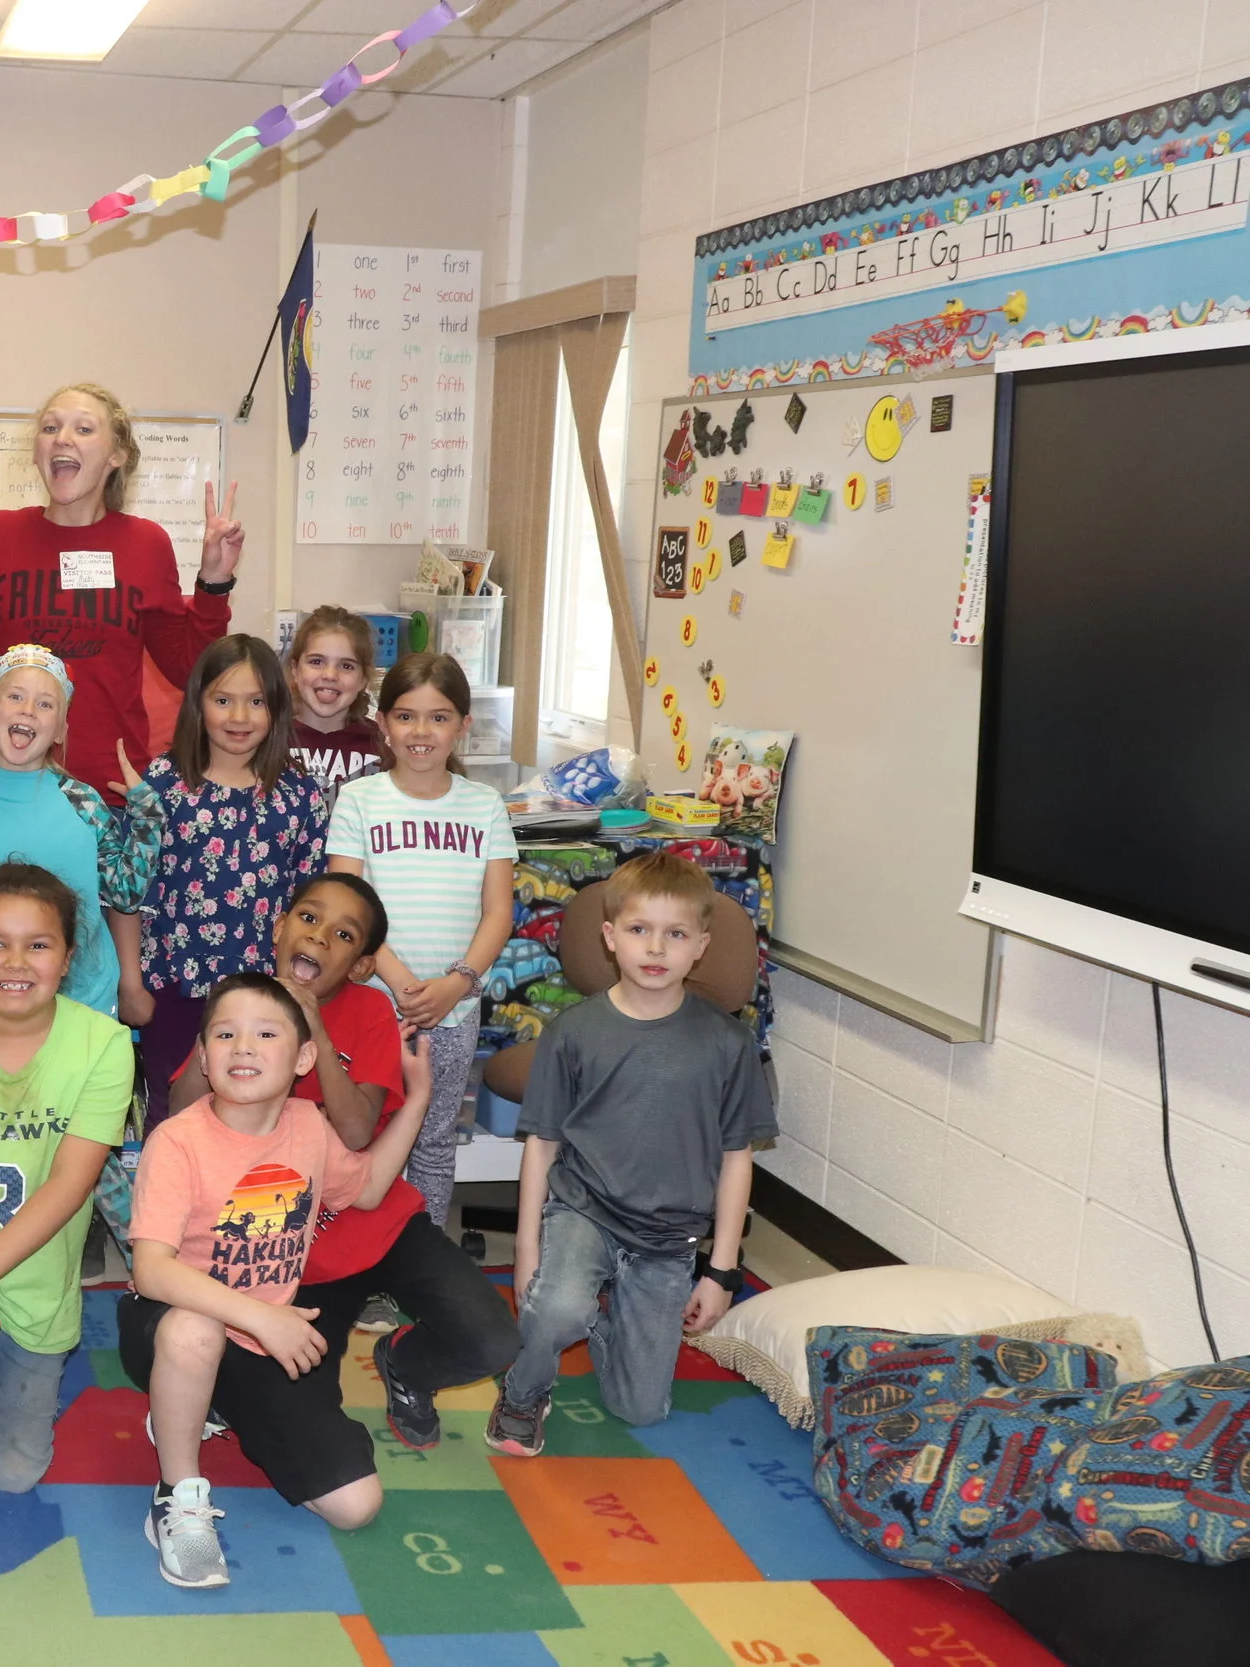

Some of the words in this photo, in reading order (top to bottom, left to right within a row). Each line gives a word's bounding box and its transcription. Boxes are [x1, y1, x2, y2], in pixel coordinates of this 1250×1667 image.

[707, 287, 730, 316] Aa
[744, 277, 763, 308] Bb
[777, 269, 800, 301] Cc
[813, 261, 837, 295] Dd
[855, 250, 876, 286] Ee
[897, 236, 919, 276] Ff
[929, 230, 960, 280] Gg
[982, 218, 1013, 257] Hh
[1041, 204, 1054, 245] Ii
[1083, 191, 1112, 252] Jj
[1140, 175, 1178, 224] Kk
[1207, 158, 1242, 209] Ll
[354, 255, 378, 270] one
[442, 254, 471, 274] first
[315, 281, 323, 298] 2
[354, 285, 375, 300] two
[402, 284, 421, 302] 2nd
[437, 288, 473, 303] second
[315, 310, 322, 328] 3
[347, 313, 380, 330] three
[402, 313, 419, 331] 3rd
[439, 315, 468, 333] third
[310, 372, 320, 390] 5
[350, 373, 372, 391] five
[436, 374, 465, 392] fifth
[309, 401, 318, 419] 6
[352, 403, 370, 418] six
[435, 404, 466, 422] sixth
[139, 434, 164, 442] Coding
[166, 435, 189, 443] Words
[309, 432, 318, 448] 7
[343, 437, 375, 449] seven
[431, 434, 468, 450] seventh
[306, 461, 315, 481] 8
[342, 461, 374, 478] eight
[430, 463, 465, 482] eighth
[705, 480, 714, 504] 12
[848, 478, 859, 506] 7
[302, 522, 317, 539] 10
[347, 523, 366, 538] ten
[429, 525, 460, 539] tenth
[698, 520, 707, 545] 11
[661, 535, 685, 559] ABC
[661, 561, 682, 585] 123
[709, 553, 716, 575] 1
[692, 566, 702, 590] 10
[683, 620, 691, 641] 8
[711, 680, 719, 702] 3
[673, 716, 681, 737] 5
[678, 745, 686, 766] 4
[370, 820, 418, 855] OLD
[424, 820, 485, 858] NAVY
[212, 1229, 307, 1266] HAKUNA
[207, 1261, 303, 1291] MATATA
[403, 1532, 463, 1575] CO
